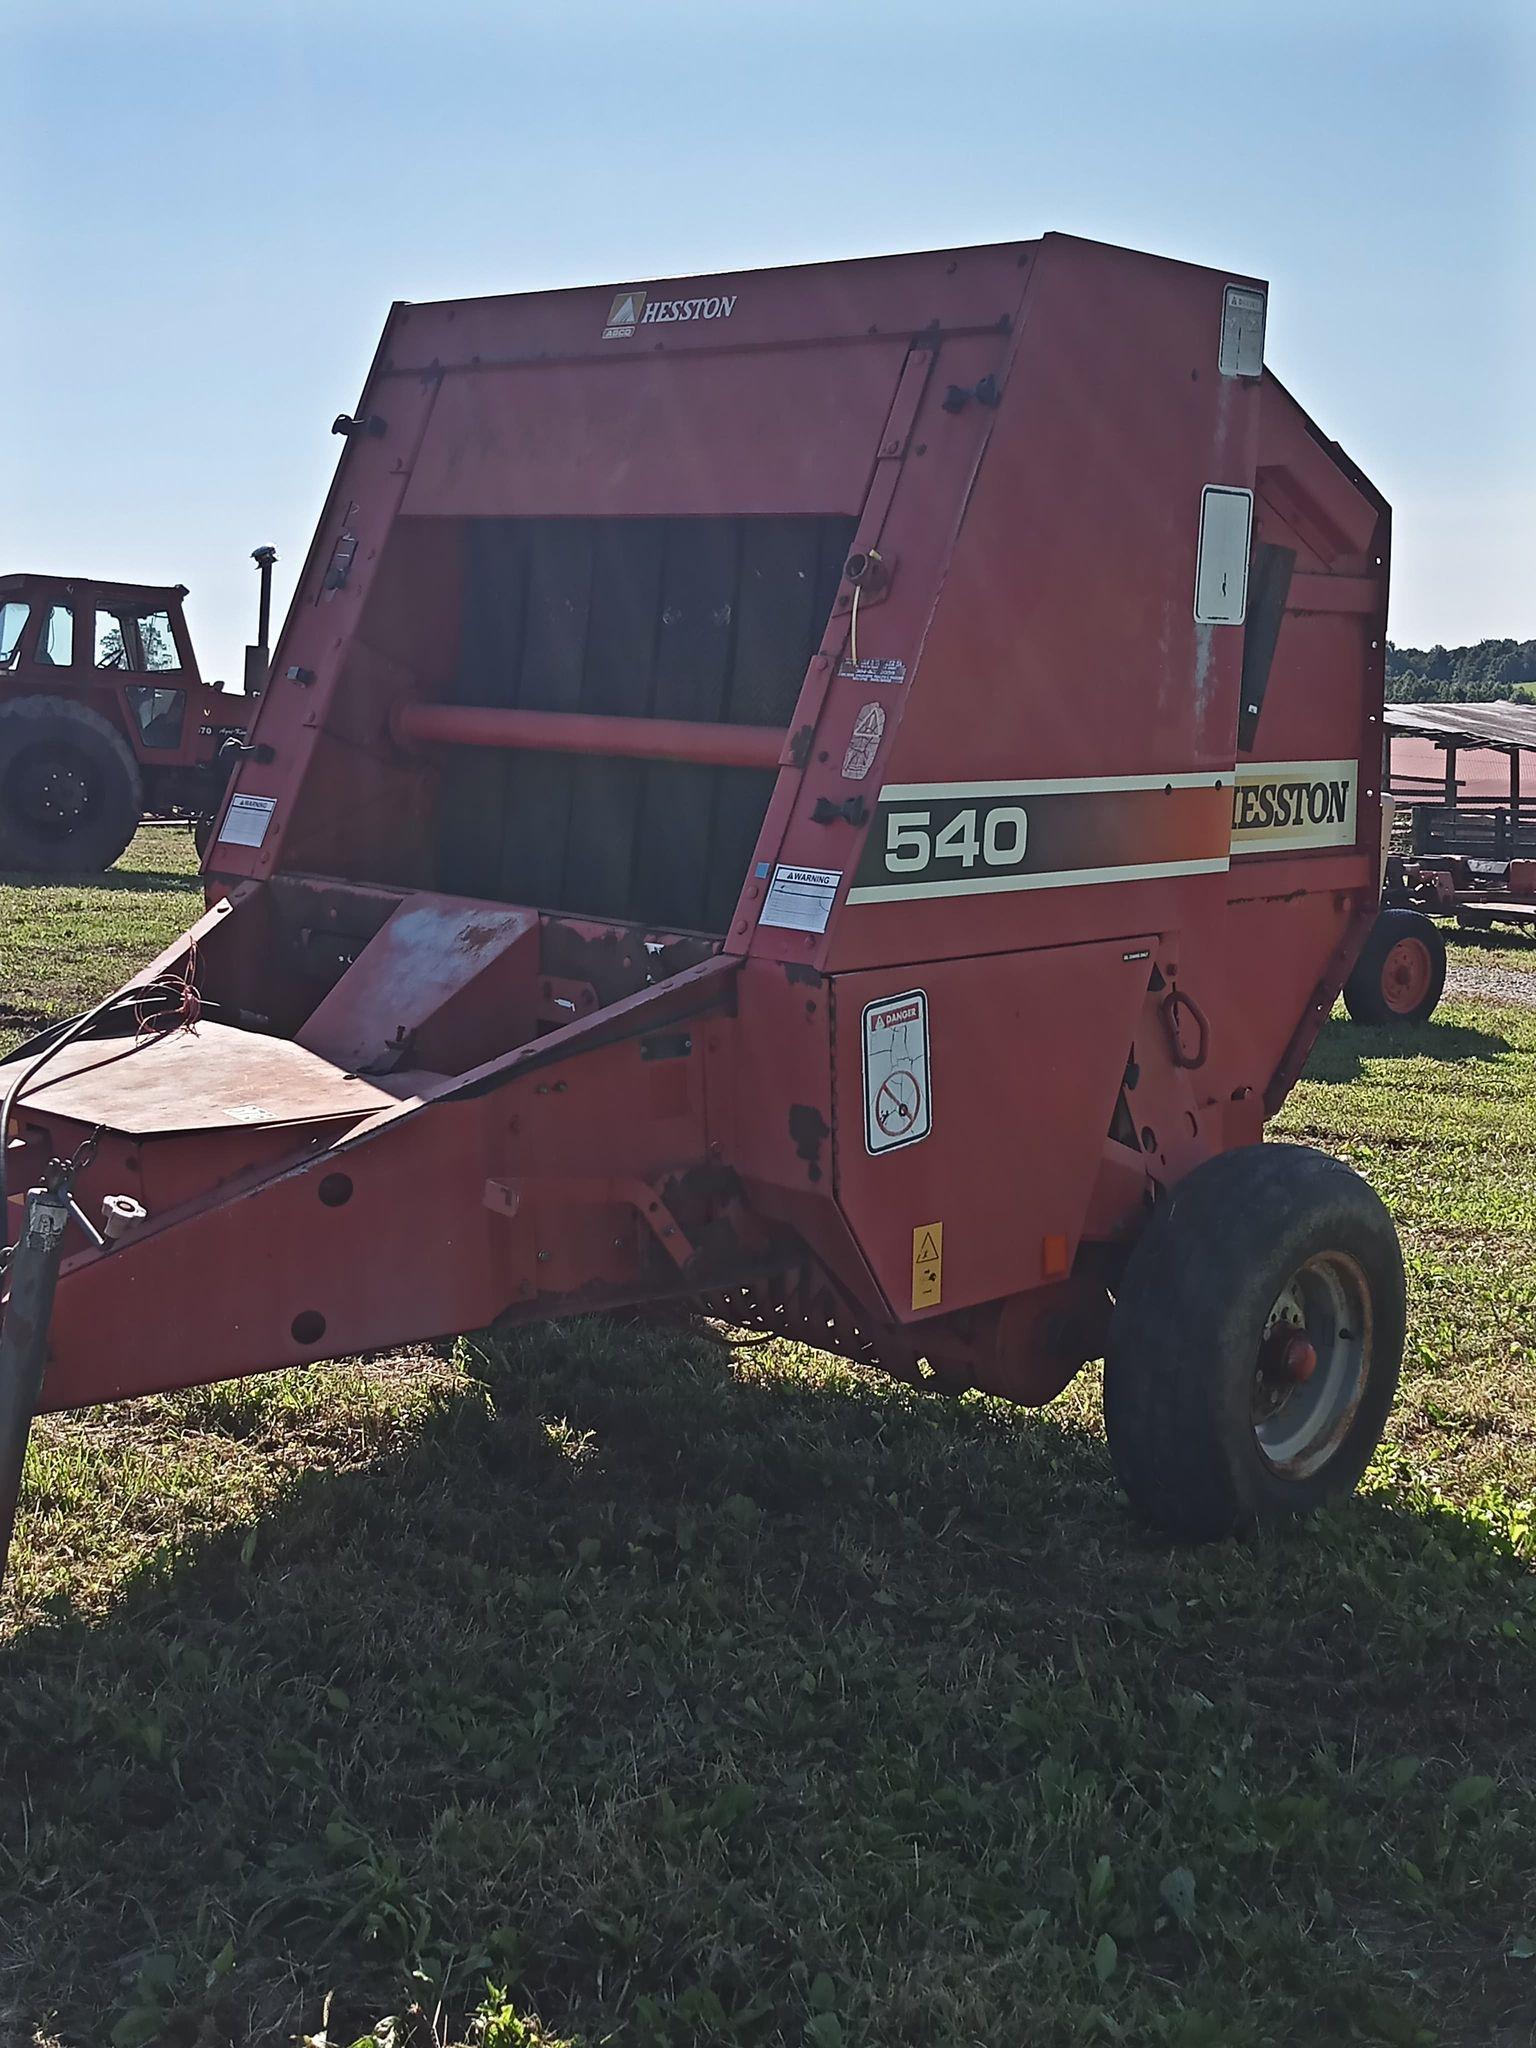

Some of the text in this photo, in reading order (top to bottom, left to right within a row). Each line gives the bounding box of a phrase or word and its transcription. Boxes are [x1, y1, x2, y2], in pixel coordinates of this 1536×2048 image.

[641, 295, 738, 324] HESSTON
[884, 806, 1028, 873] 540
[794, 872, 831, 885] WARNING
[885, 1007, 917, 1025] DANGER
